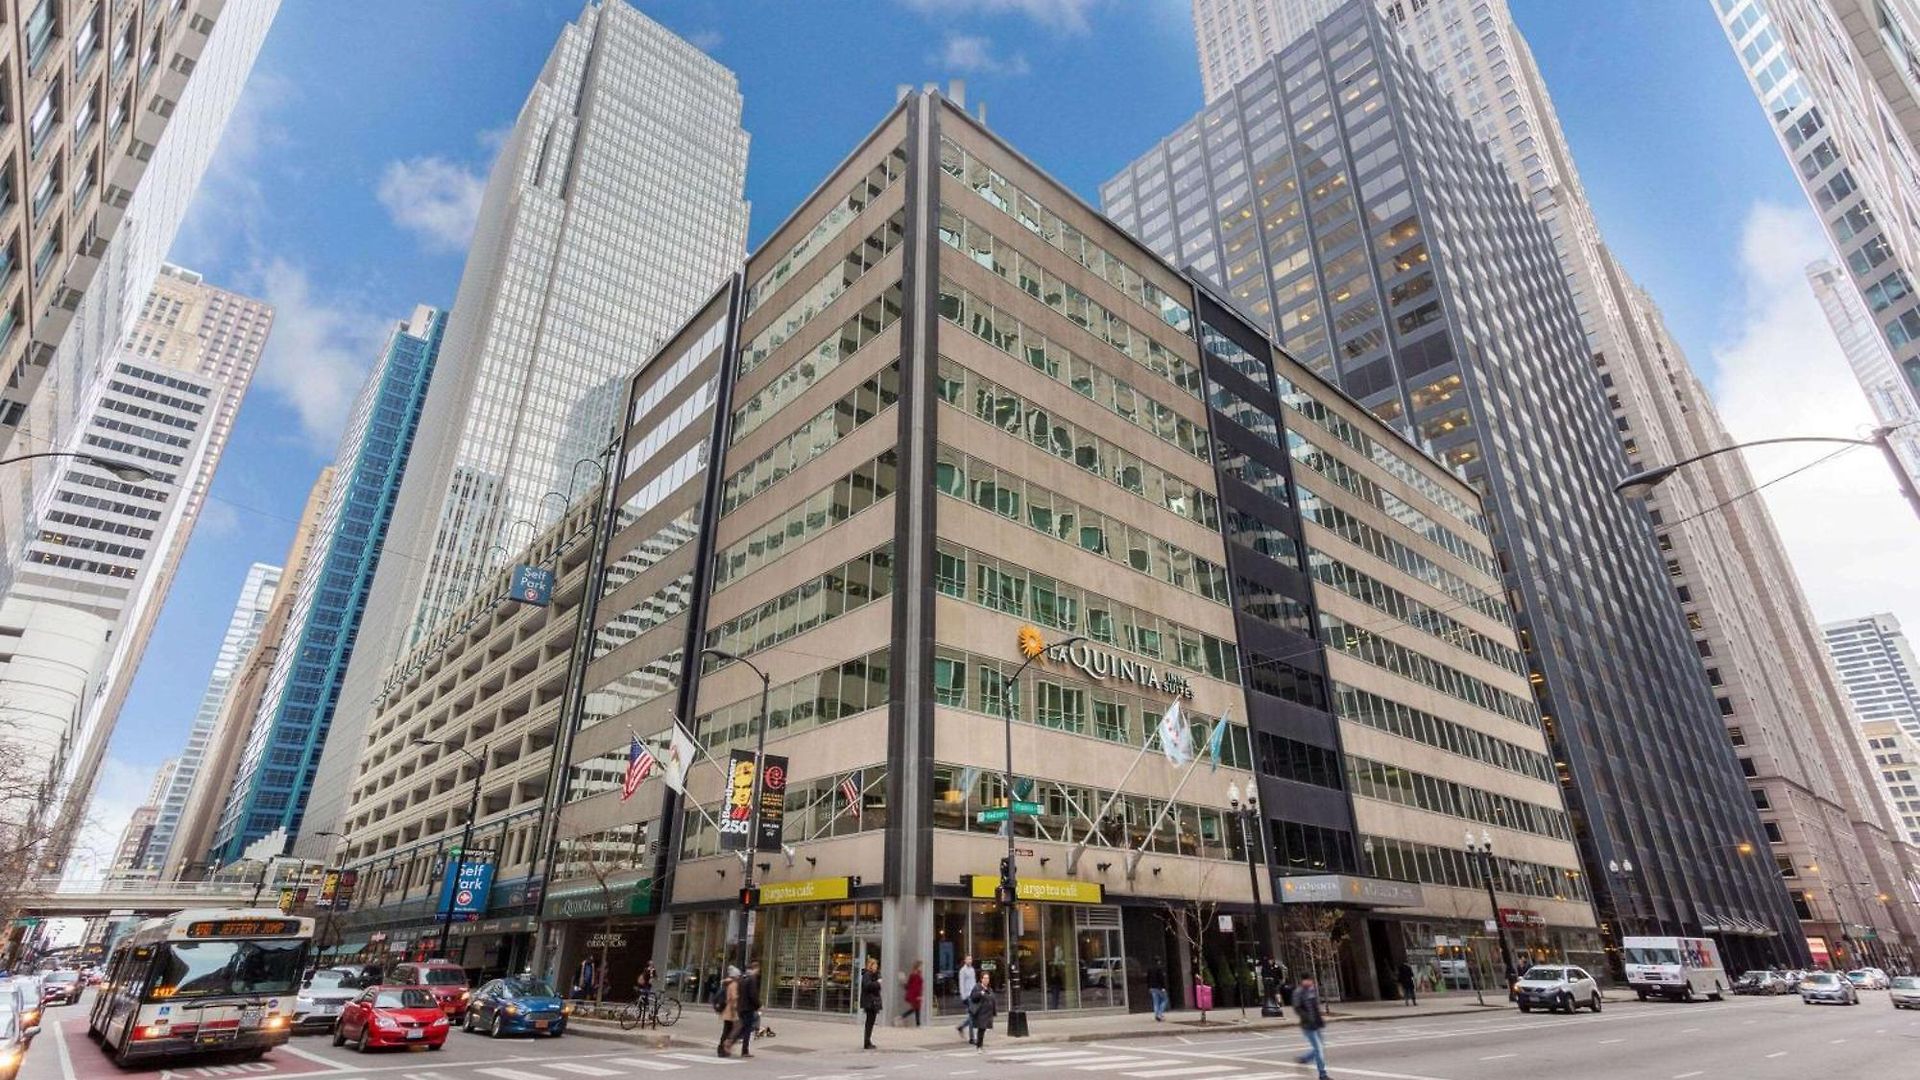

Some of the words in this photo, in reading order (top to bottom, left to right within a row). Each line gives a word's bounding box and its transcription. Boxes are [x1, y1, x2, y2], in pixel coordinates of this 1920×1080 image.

[525, 567, 546, 581] Self
[520, 576, 546, 590] Park
[1050, 647, 1068, 663] LA
[1069, 640, 1161, 690] QUINTA
[720, 818, 749, 834] 250
[458, 878, 483, 890] ark
[1023, 883, 1045, 898] argo
[1046, 884, 1060, 896] tea
